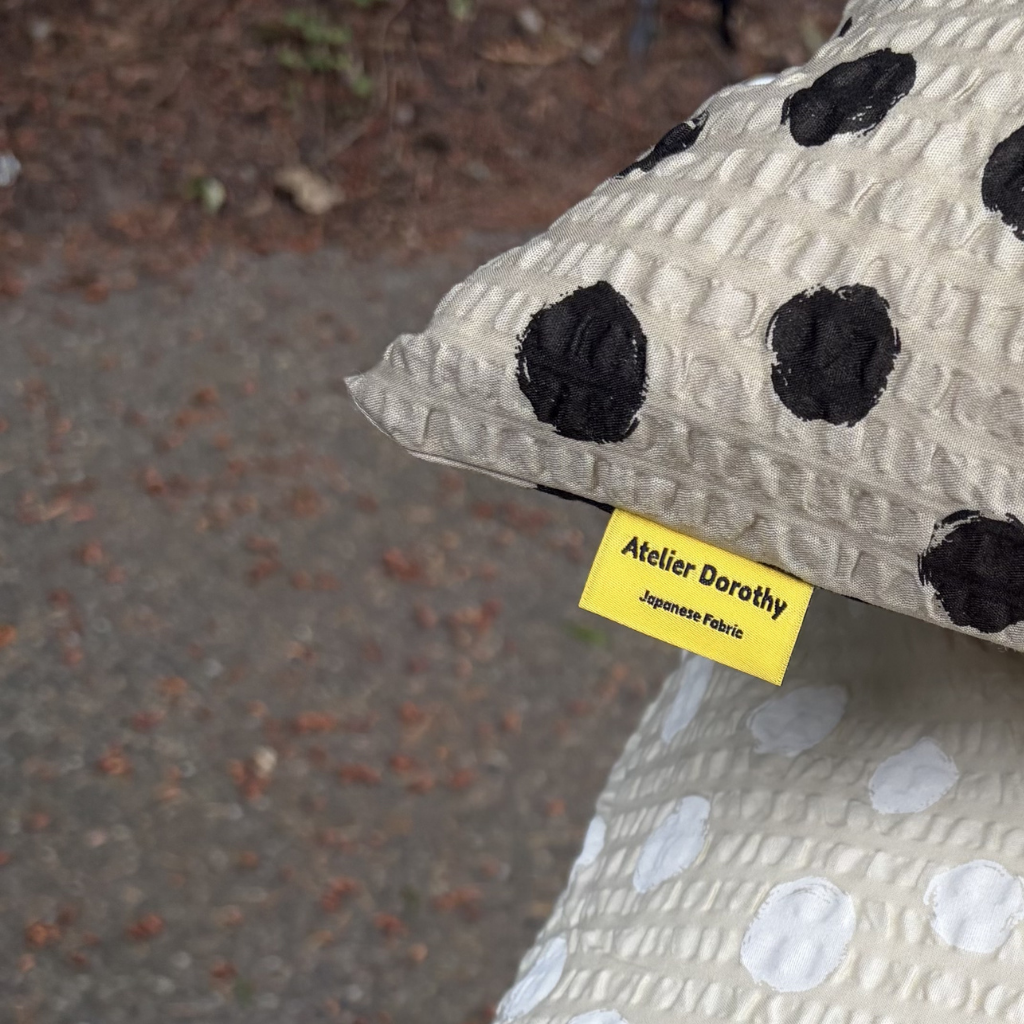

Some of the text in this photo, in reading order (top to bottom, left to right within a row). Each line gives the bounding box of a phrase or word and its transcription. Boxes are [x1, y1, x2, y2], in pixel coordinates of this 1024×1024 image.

[621, 536, 788, 620] Atelier Dorothy
[639, 590, 743, 640] Japanese Fabric
